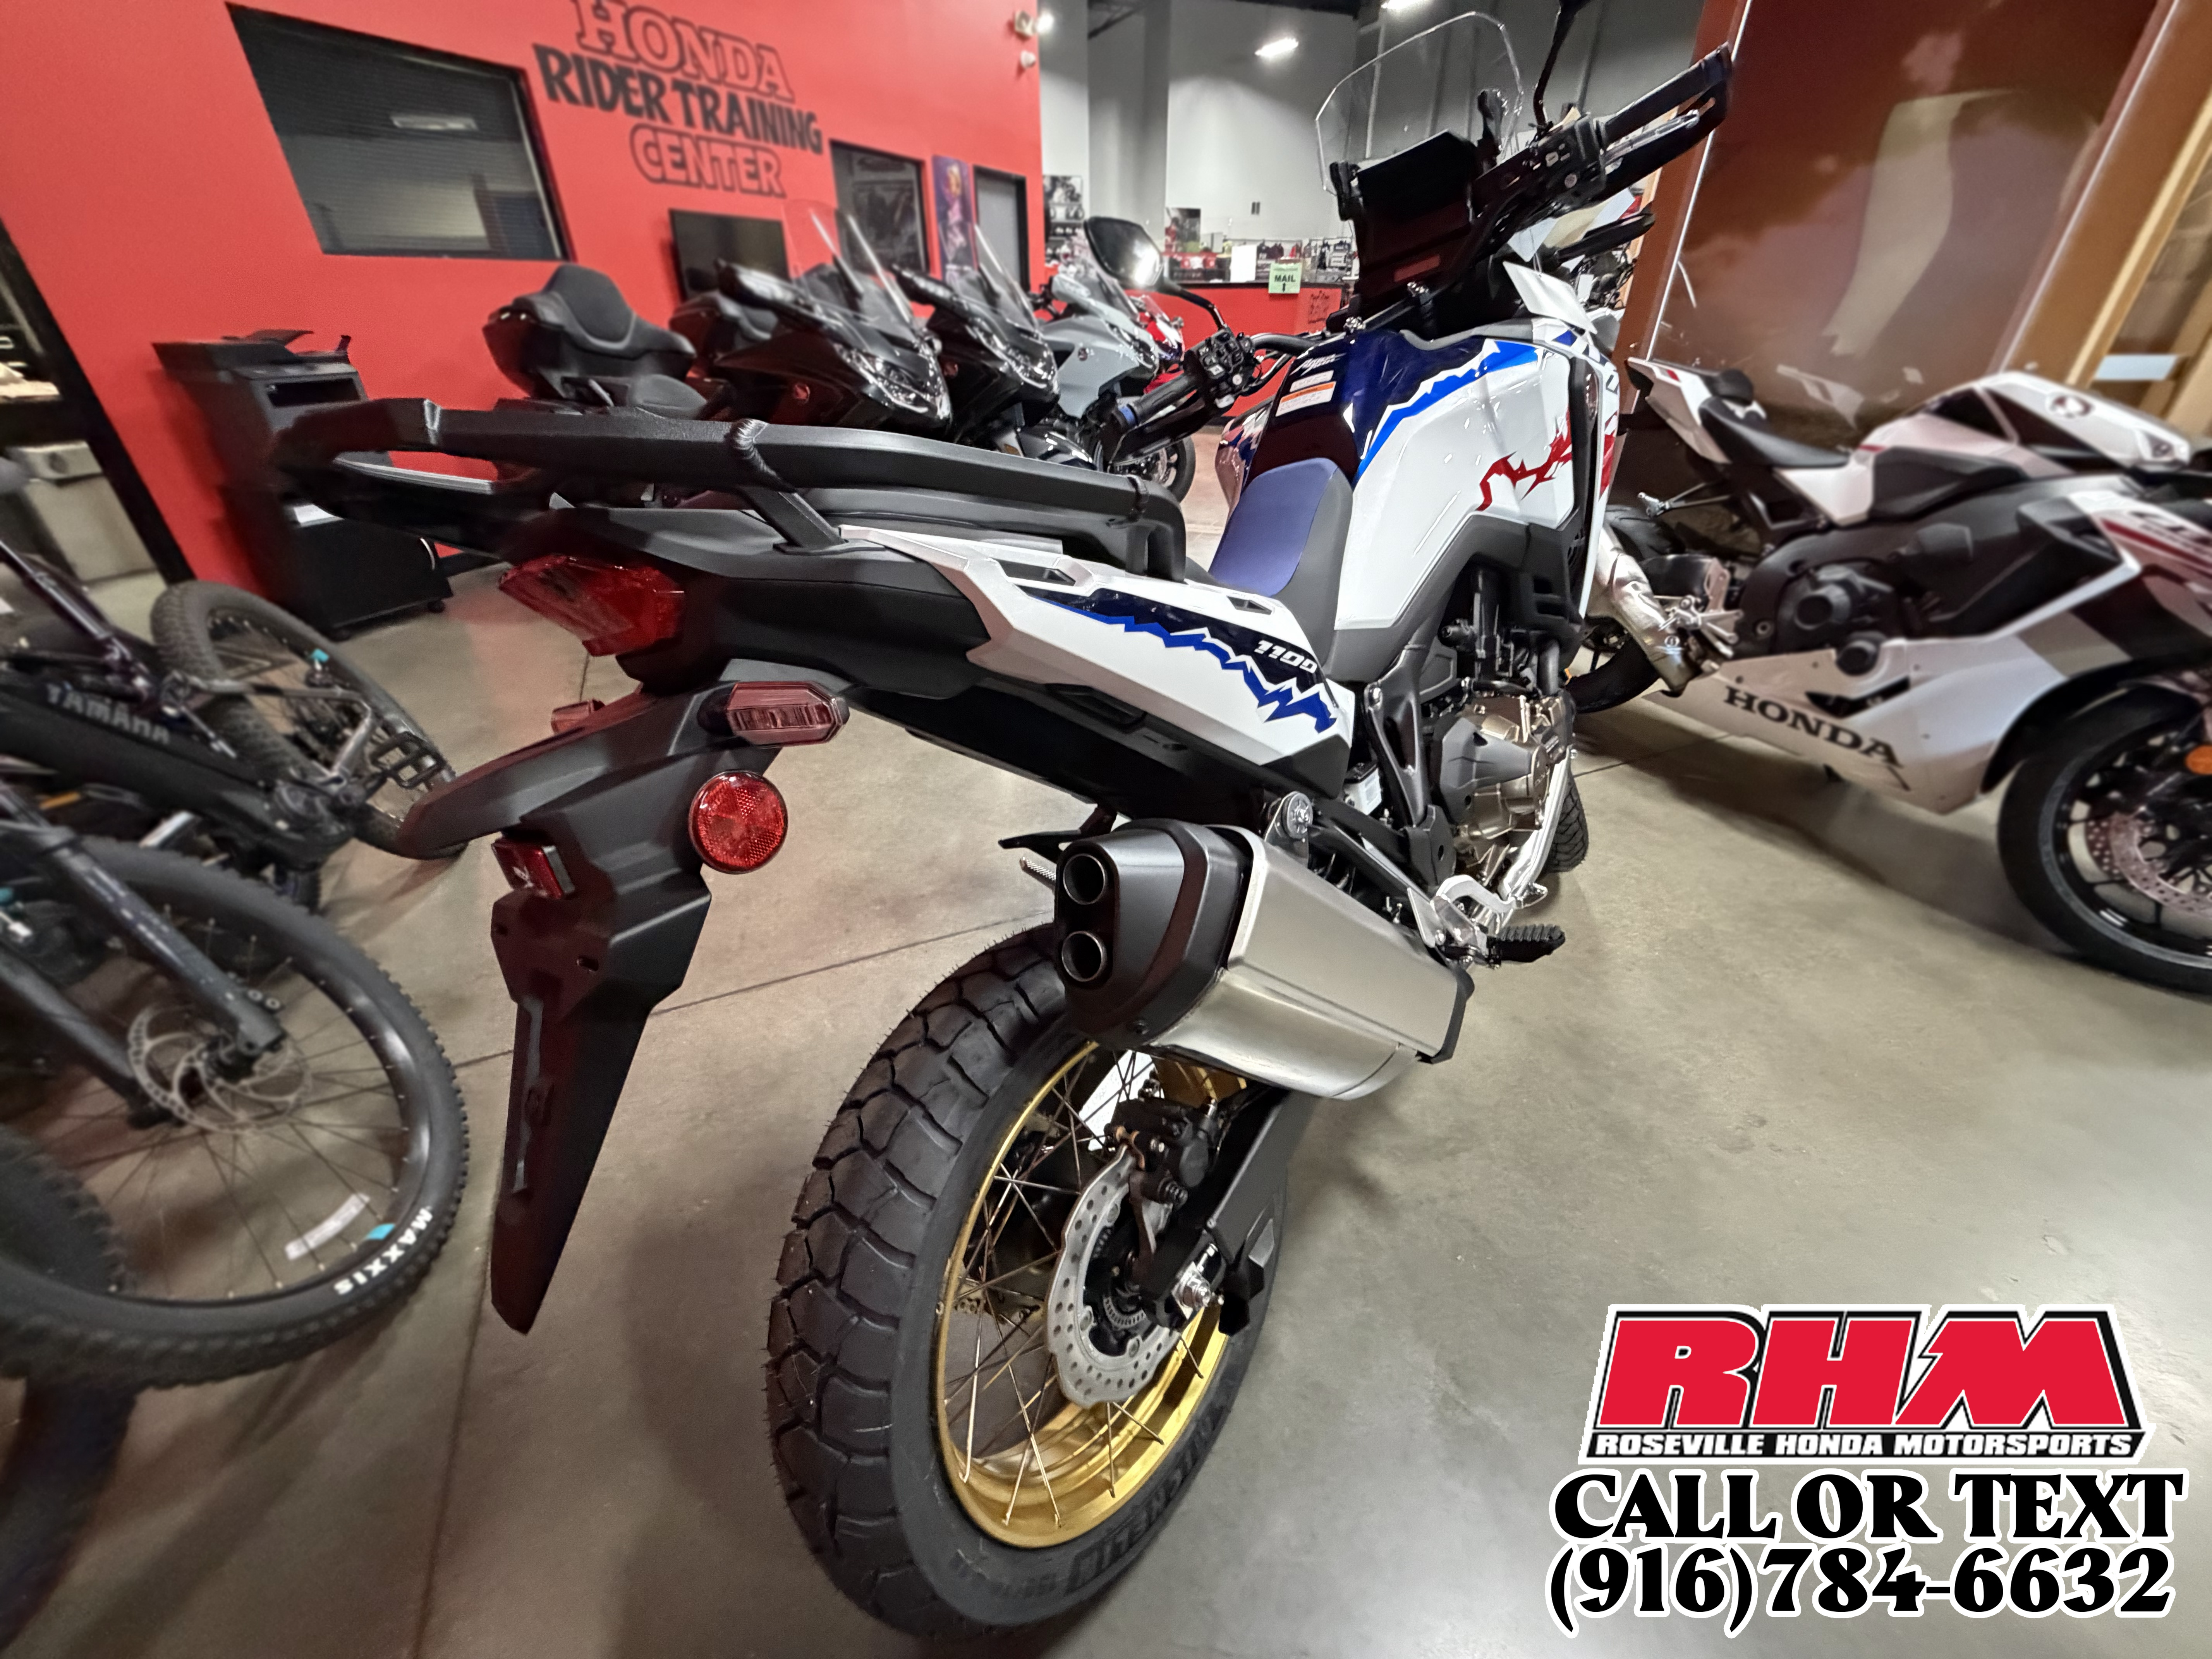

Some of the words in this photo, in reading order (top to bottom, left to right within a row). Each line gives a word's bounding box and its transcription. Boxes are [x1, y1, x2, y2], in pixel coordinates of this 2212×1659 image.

[570, 0, 795, 103] HONDA
[533, 43, 672, 124] RIDER
[671, 78, 823, 154] TRAINING
[630, 123, 786, 198] CENTER
[1274, 274, 1296, 282] MAIL
[1254, 640, 1317, 674] 1100
[1724, 685, 1905, 767] HONDA
[333, 1208, 433, 1295] MAXXIS
